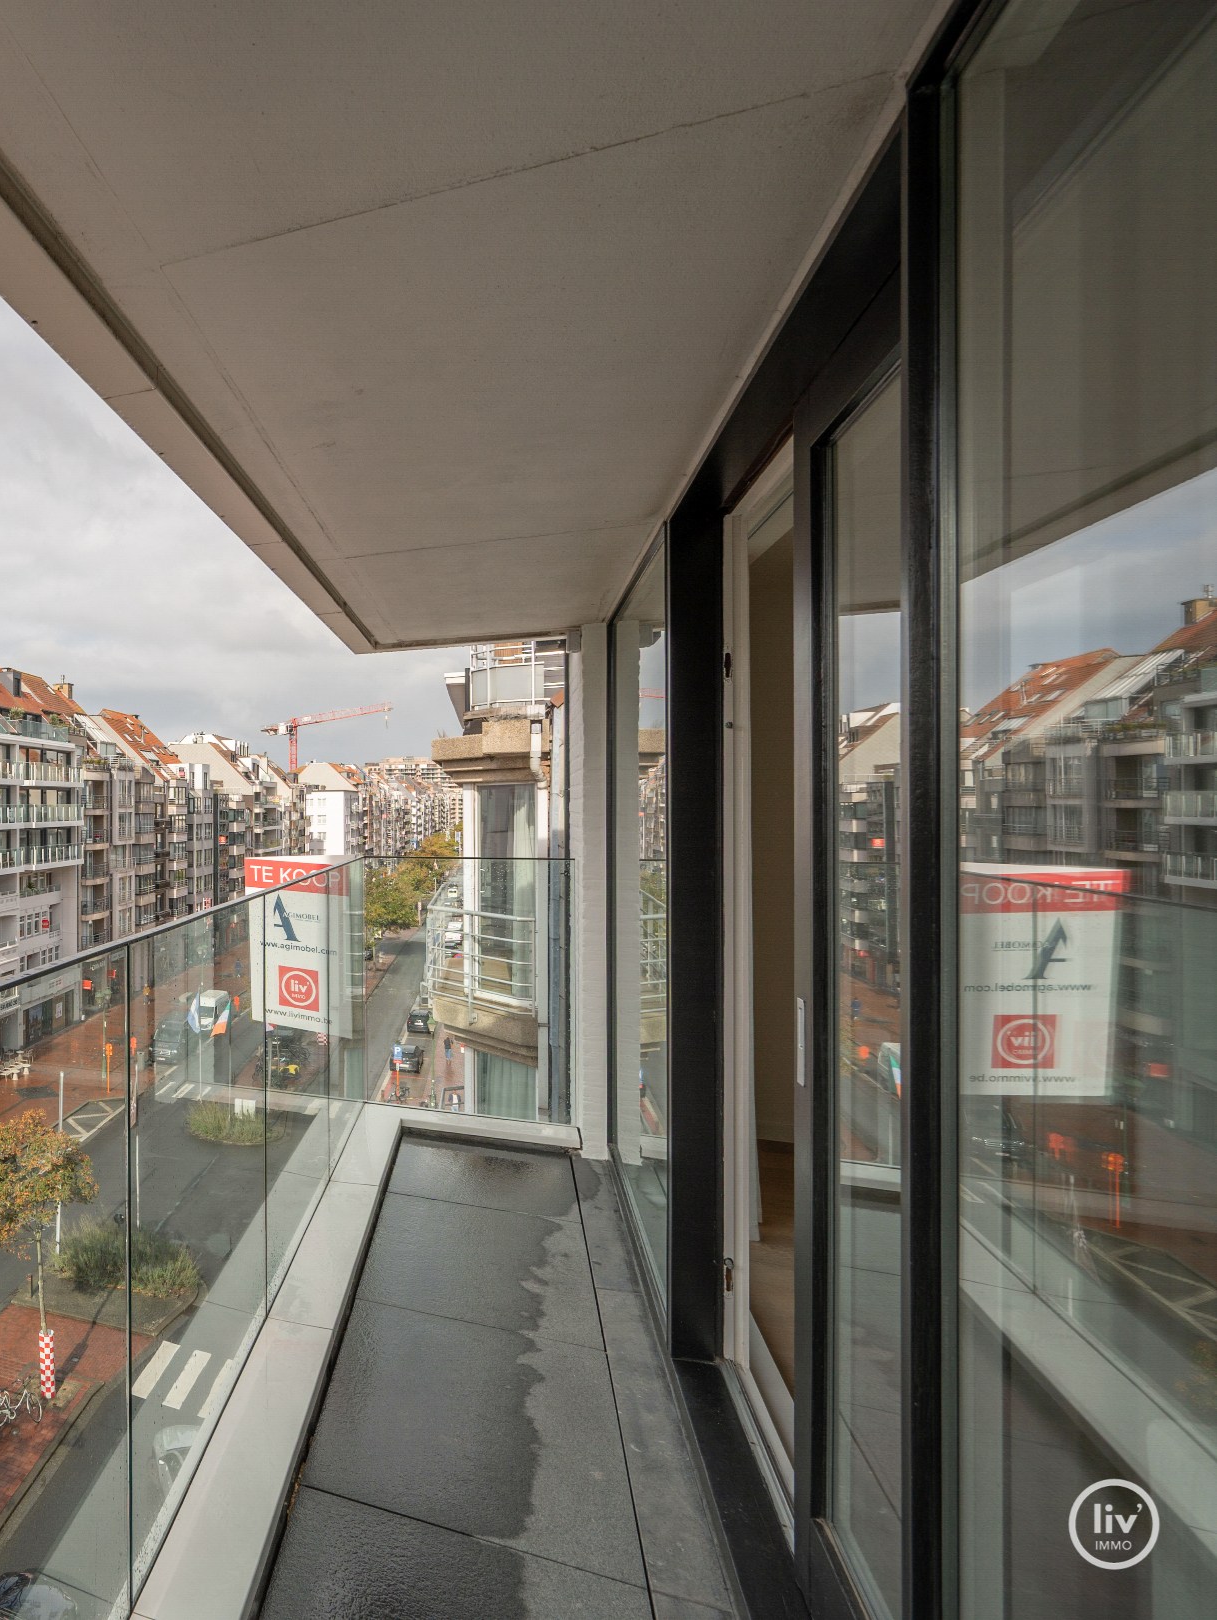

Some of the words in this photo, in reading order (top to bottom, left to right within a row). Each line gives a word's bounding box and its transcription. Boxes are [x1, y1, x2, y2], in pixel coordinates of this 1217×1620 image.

[250, 866, 274, 883] TE
[279, 867, 340, 887] KOOP
[259, 941, 337, 956] www.agimobel.com
[264, 1008, 333, 1025] www.livimmo.be
[394, 1046, 401, 1055] P
